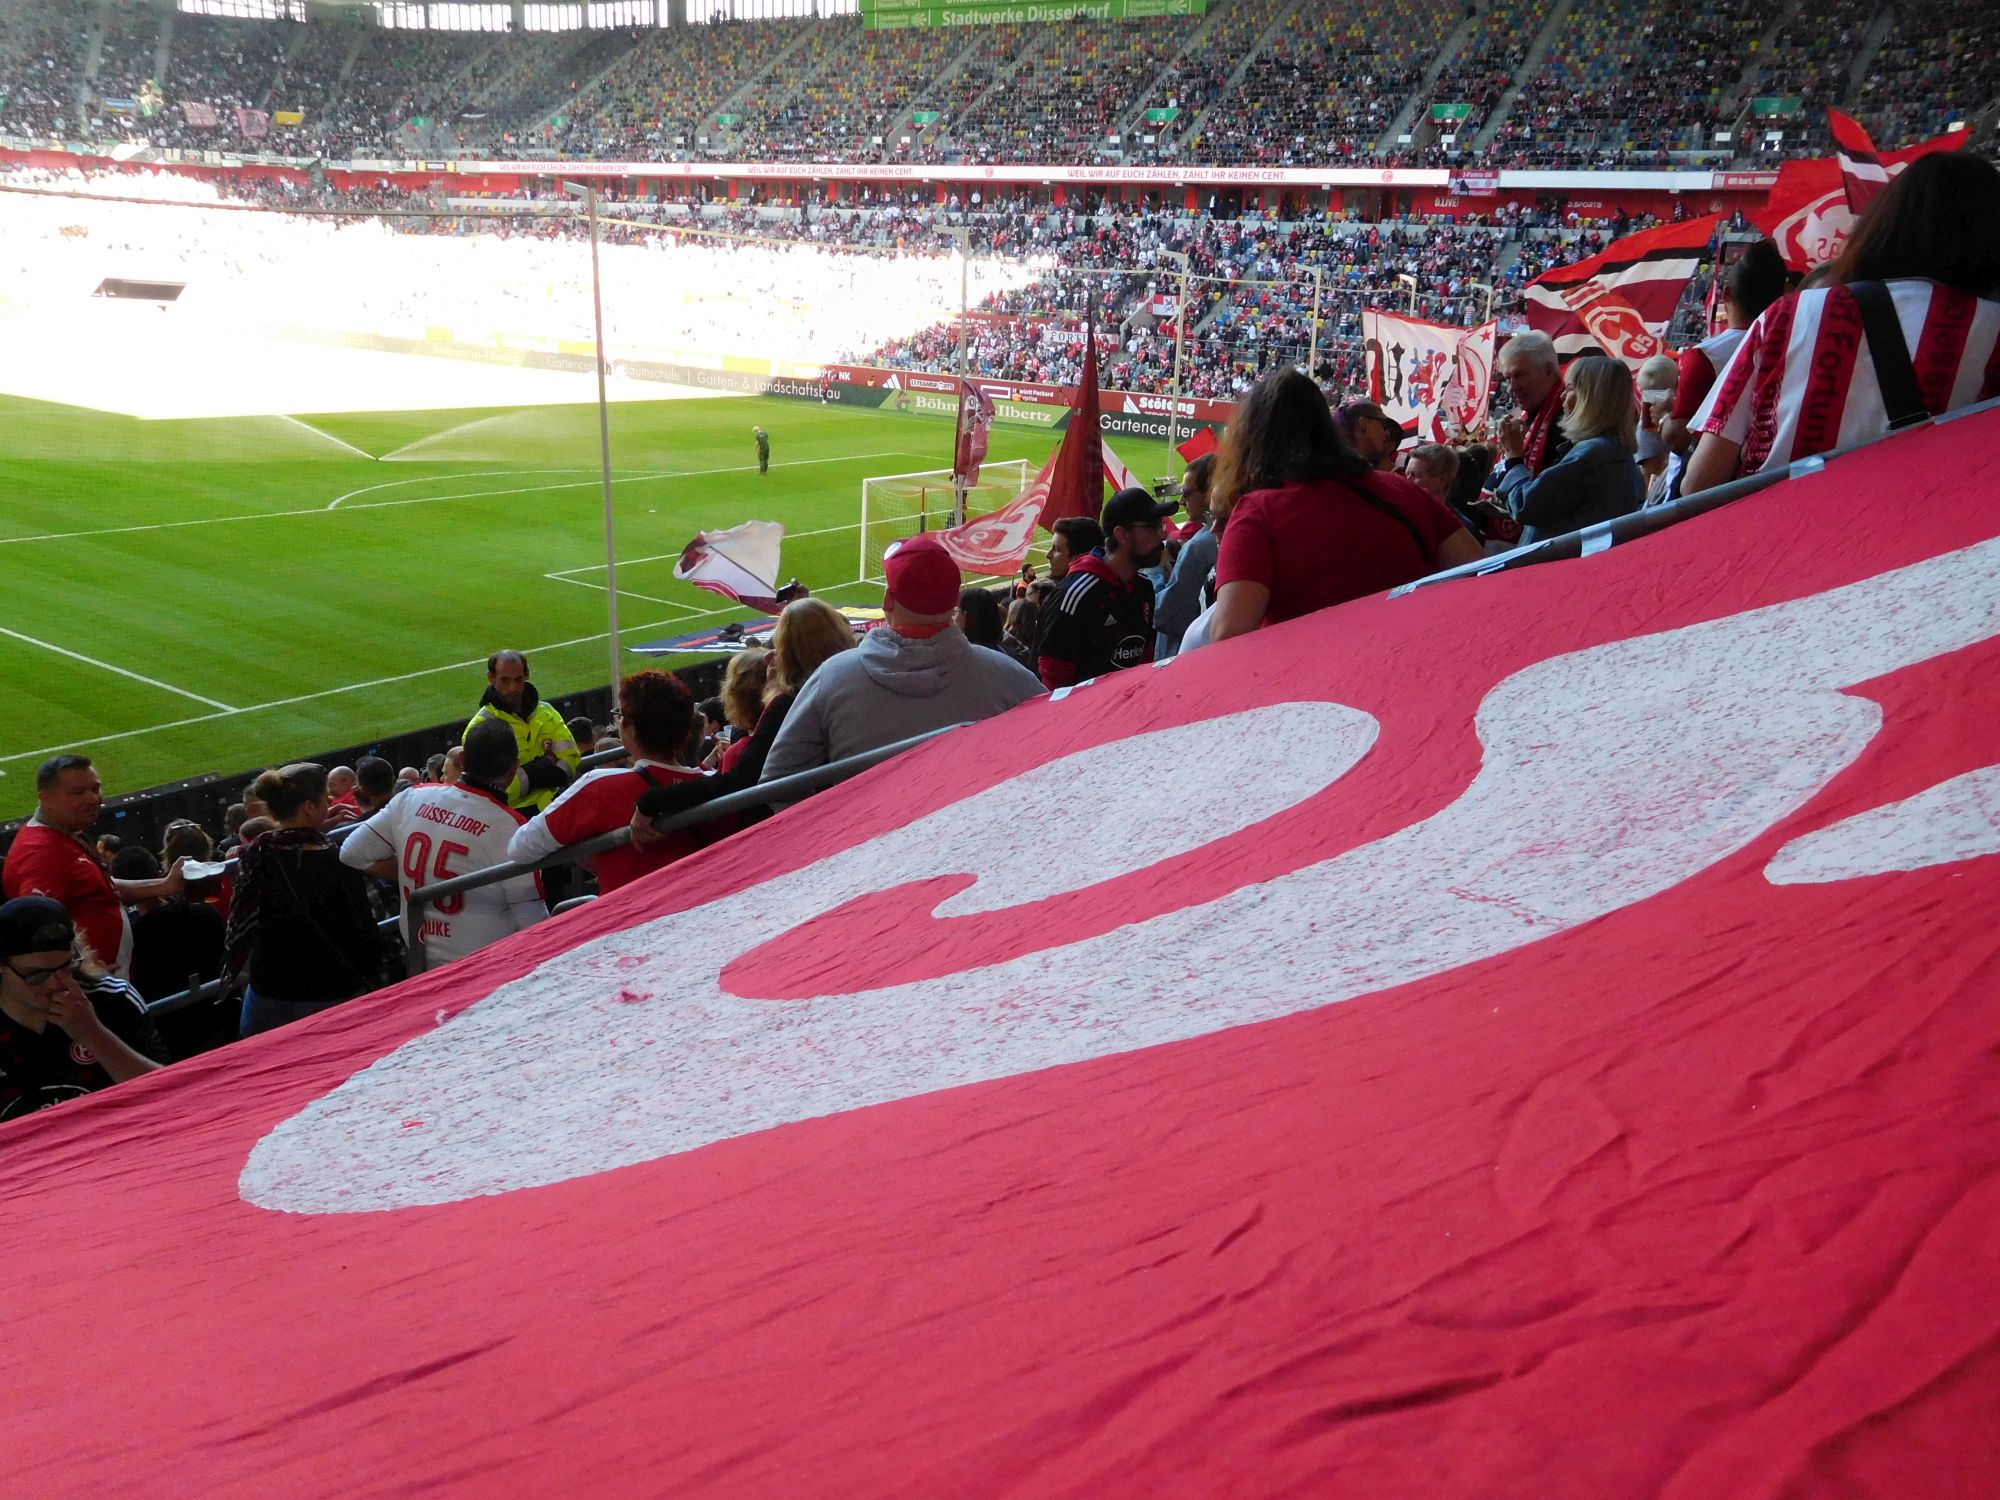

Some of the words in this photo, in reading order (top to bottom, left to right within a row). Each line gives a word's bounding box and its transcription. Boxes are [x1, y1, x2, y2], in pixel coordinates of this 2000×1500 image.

[942, 8, 1024, 26] Stadtwerke
[1028, 3, 1110, 22] Düsseldorf
[808, 166, 834, 176] ZÄHLEN,
[1146, 169, 1181, 179] ZÄHLEN,
[1228, 171, 1259, 179] KEINEN
[1262, 171, 1286, 180] CENT.
[1630, 333, 1654, 354] 95
[1033, 390, 1054, 398] Packard
[415, 802, 490, 836] DÜSSELDORF
[403, 832, 469, 915] 95
